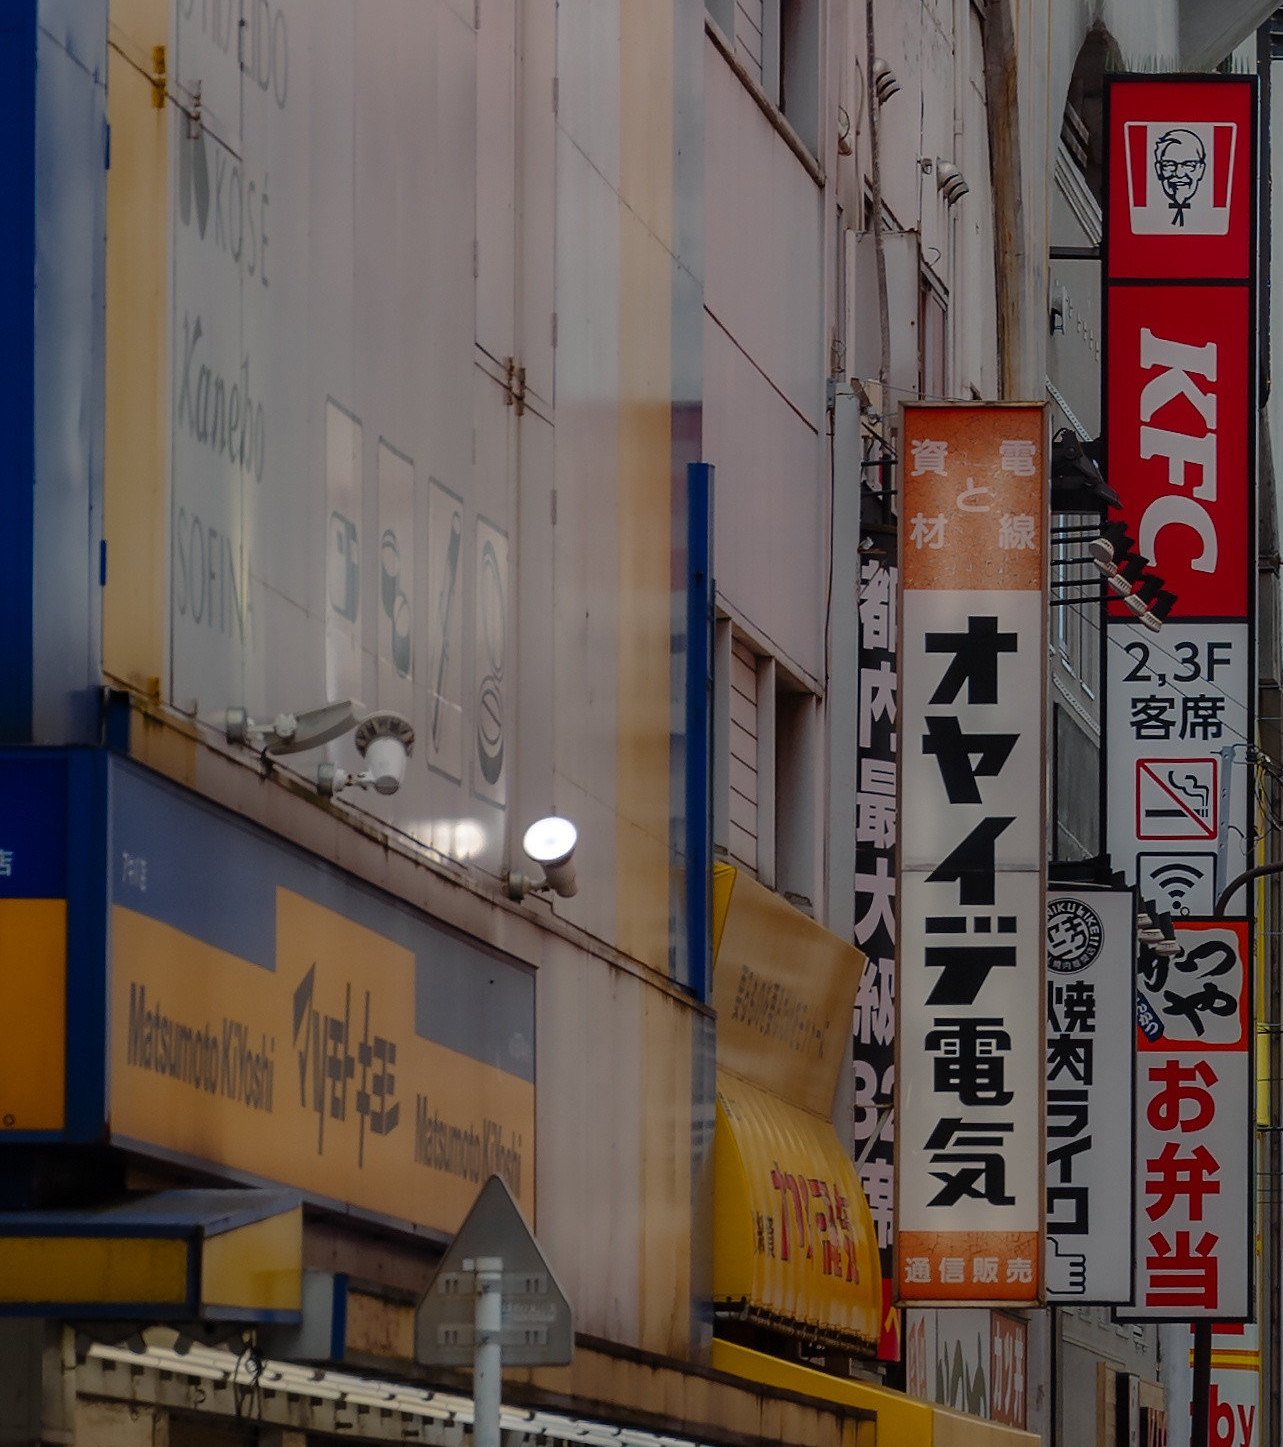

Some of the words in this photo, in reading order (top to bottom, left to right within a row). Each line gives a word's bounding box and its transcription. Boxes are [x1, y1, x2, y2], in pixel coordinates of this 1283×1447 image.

[908, 439, 949, 551] 資材
[955, 476, 992, 513] と
[998, 439, 1038, 551] 電線
[1138, 326, 1220, 575] KFC
[1123, 639, 1235, 685] 2,3F
[1128, 693, 1227, 743] 客席
[921, 615, 1021, 1209] オヤイデ電気
[128, 982, 218, 1093] Matsumoto
[415, 1093, 481, 1181] Matsumoto
[1144, 1058, 1222, 1310] お弁当
[903, 1256, 1034, 1285] 通信販売
